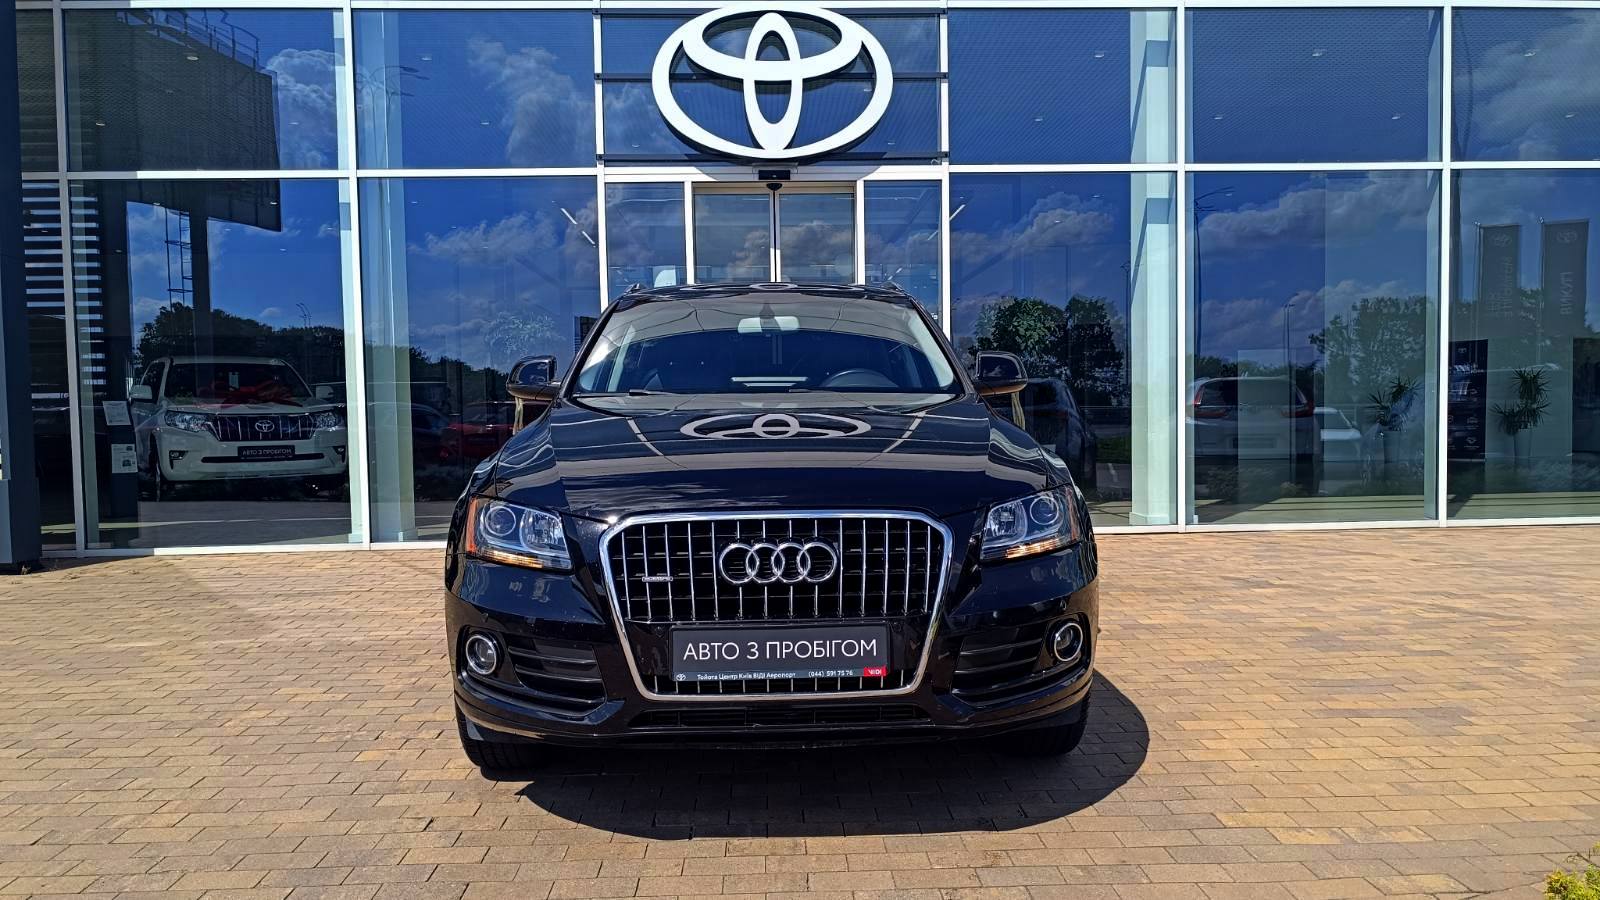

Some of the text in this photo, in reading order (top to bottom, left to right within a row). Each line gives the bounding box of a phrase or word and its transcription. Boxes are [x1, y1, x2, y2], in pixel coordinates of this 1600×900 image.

[682, 638, 877, 661] АВТО З ПРОБІГОМ
[766, 671, 796, 679] Аеропорт
